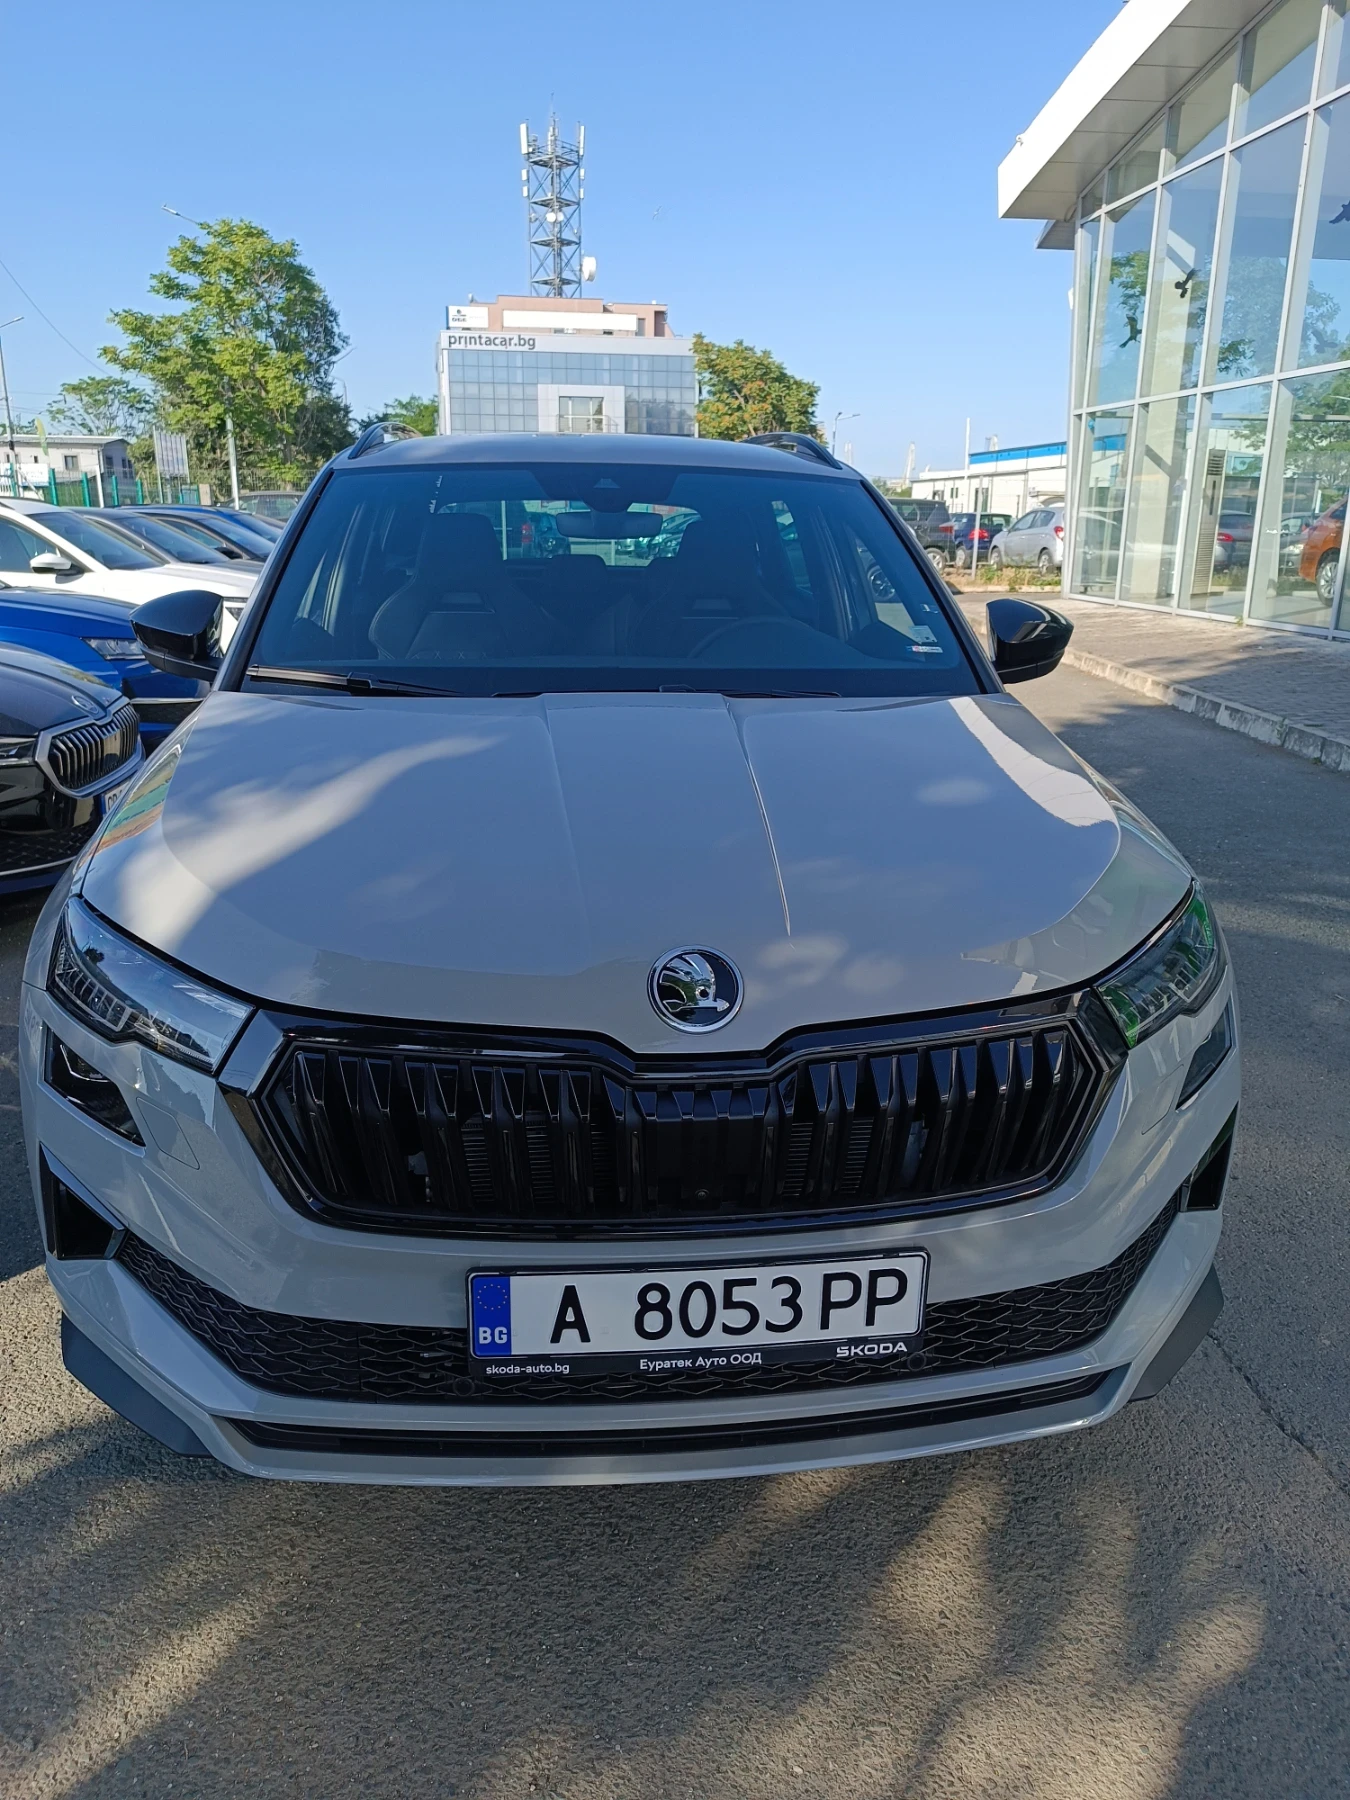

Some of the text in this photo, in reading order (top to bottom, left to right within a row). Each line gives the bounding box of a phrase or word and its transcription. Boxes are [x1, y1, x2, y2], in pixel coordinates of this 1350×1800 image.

[448, 334, 536, 350] printacar.bg
[550, 1268, 908, 1344] A 8053 PP
[478, 1326, 508, 1344] BG
[485, 1363, 570, 1375] skoda-auto.bg
[639, 1352, 763, 1371] Еуратек Ауто ООД
